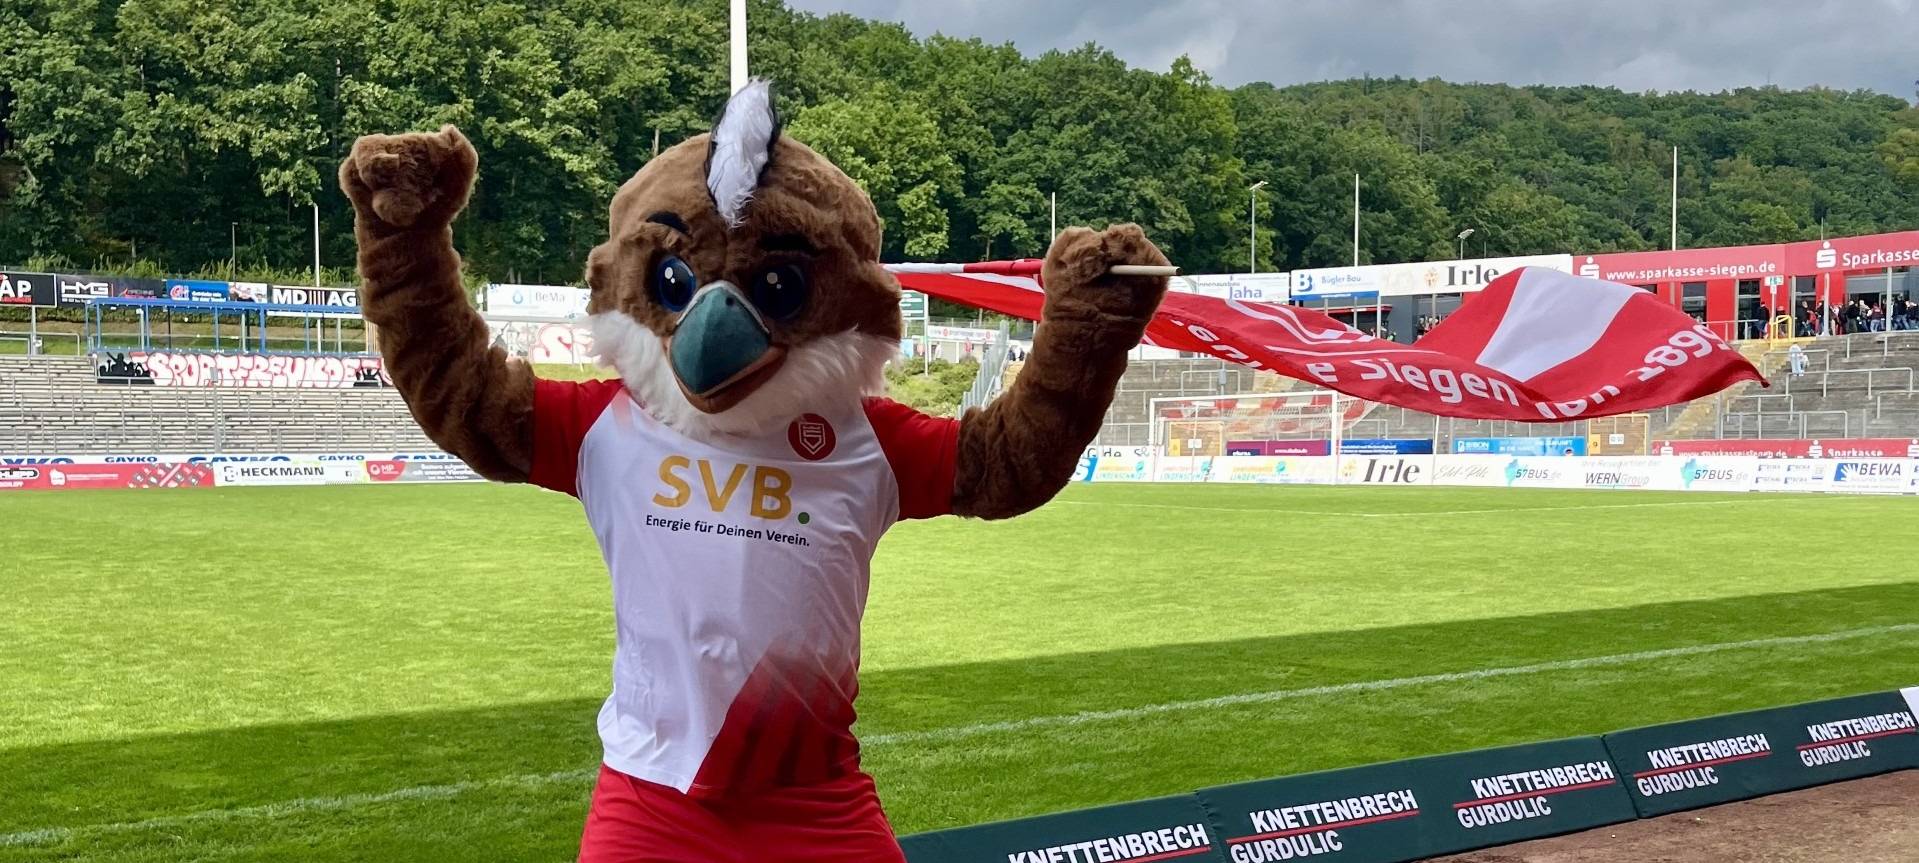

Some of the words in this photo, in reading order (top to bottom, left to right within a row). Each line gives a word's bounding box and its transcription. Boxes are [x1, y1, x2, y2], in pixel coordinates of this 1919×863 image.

[1606, 261, 1776, 280] www.sparkasse-siegen.de
[1842, 249, 1919, 268] Sparkasse
[61, 281, 109, 295] HMG
[1447, 264, 1500, 286] Irle
[326, 291, 357, 307] AG
[1350, 358, 1520, 406] Siegen
[240, 466, 325, 477] HECKMANN
[1362, 458, 1420, 484] Irle
[1859, 462, 1902, 476] BEWA
[646, 514, 692, 532] Energie
[694, 520, 714, 533] für
[716, 523, 763, 540] Deinen
[766, 529, 811, 548] Verein.
[1807, 711, 1915, 744] KNETTENBRECH
[1647, 733, 1771, 770] KNETTENBRECH
[1800, 739, 1871, 768] GURDULIC
[1470, 760, 1614, 800] KNETTENBRECH
[1636, 766, 1720, 798] GURDULIC
[1249, 789, 1418, 834] KNETTENBRECH
[1457, 796, 1552, 829] GURDULIC
[1229, 829, 1344, 863] GURDULIC
